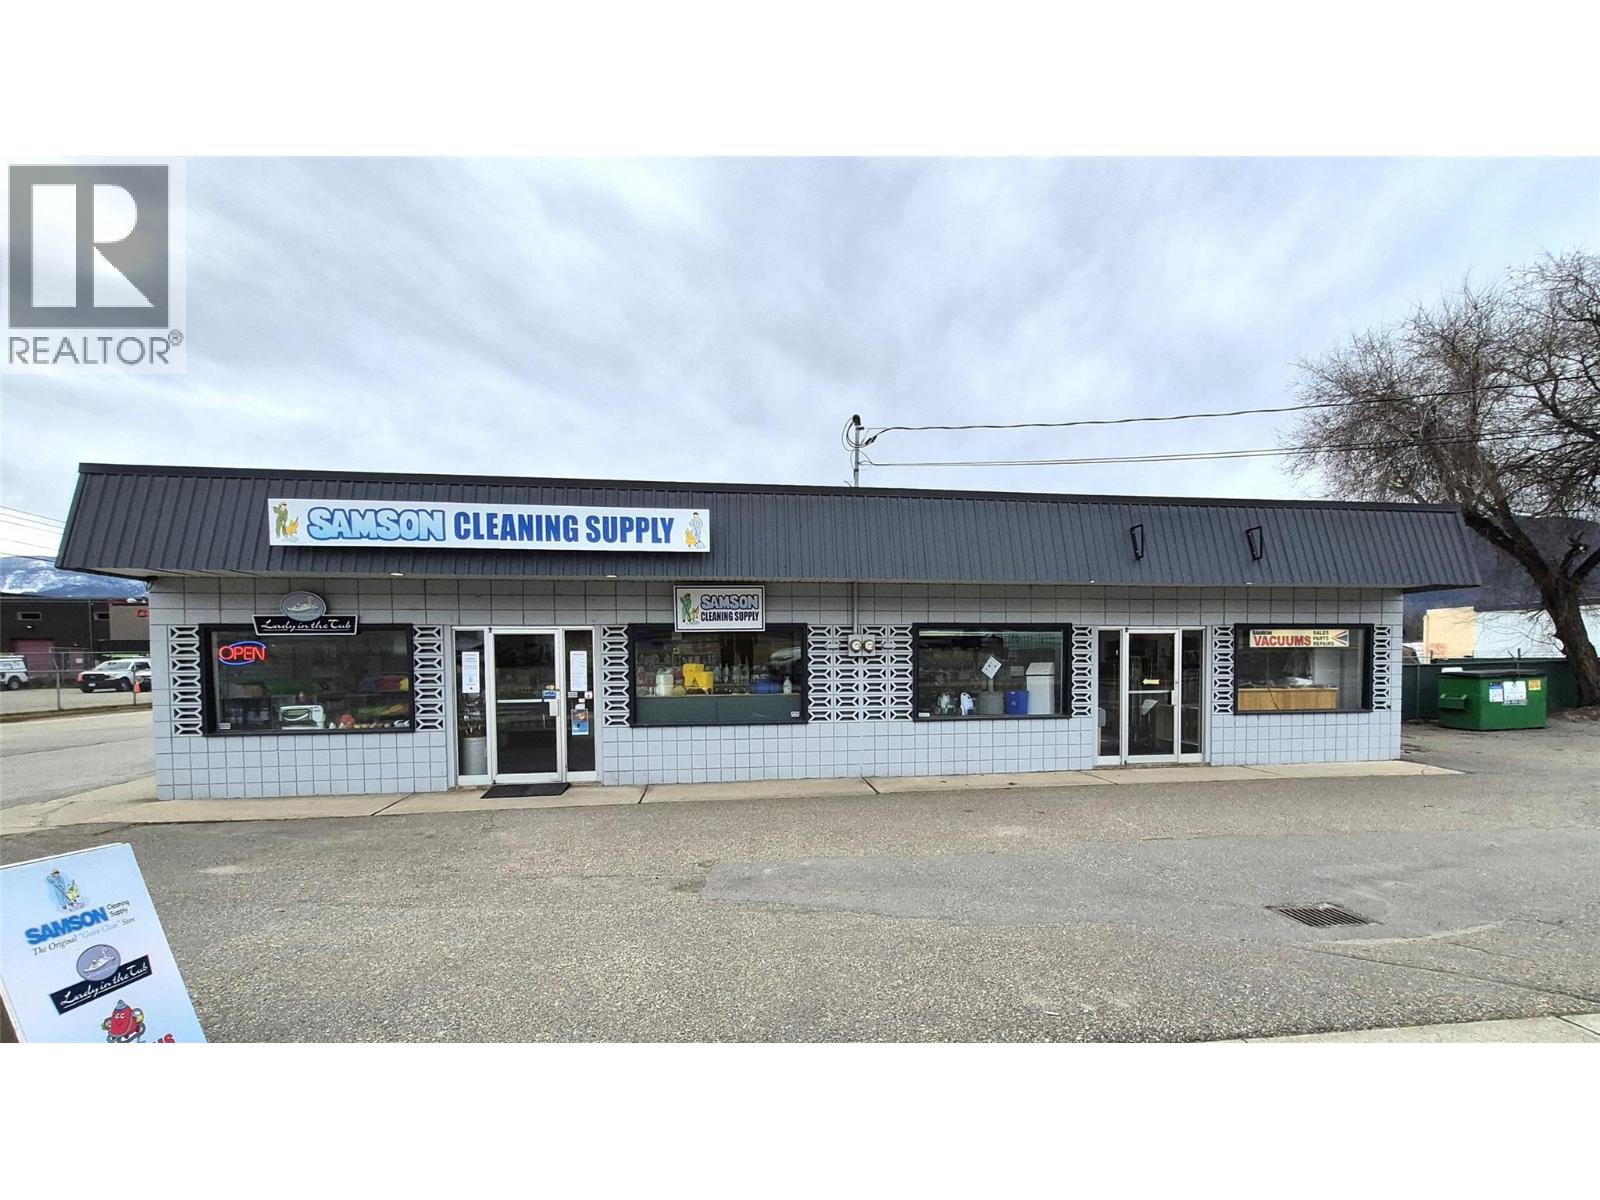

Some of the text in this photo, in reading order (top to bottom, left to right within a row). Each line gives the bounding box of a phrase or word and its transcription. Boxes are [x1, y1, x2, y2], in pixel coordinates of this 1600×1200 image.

[307, 507, 675, 544] SAMSON CLEANING SUPPLY
[701, 594, 760, 610] SAMSON
[701, 611, 760, 622] CLEANING SUPPLY
[261, 619, 295, 632] Lady
[310, 621, 329, 629] the
[328, 619, 352, 629] Tub
[1254, 635, 1312, 646] VACUUMS
[219, 645, 267, 661] OPEN
[106, 900, 130, 911] Cleaning
[109, 908, 128, 918] Supply
[25, 907, 109, 945] SAMSON
[33, 945, 47, 956] The
[48, 934, 78, 951] Original
[60, 962, 149, 1006] Lady in the Tub
